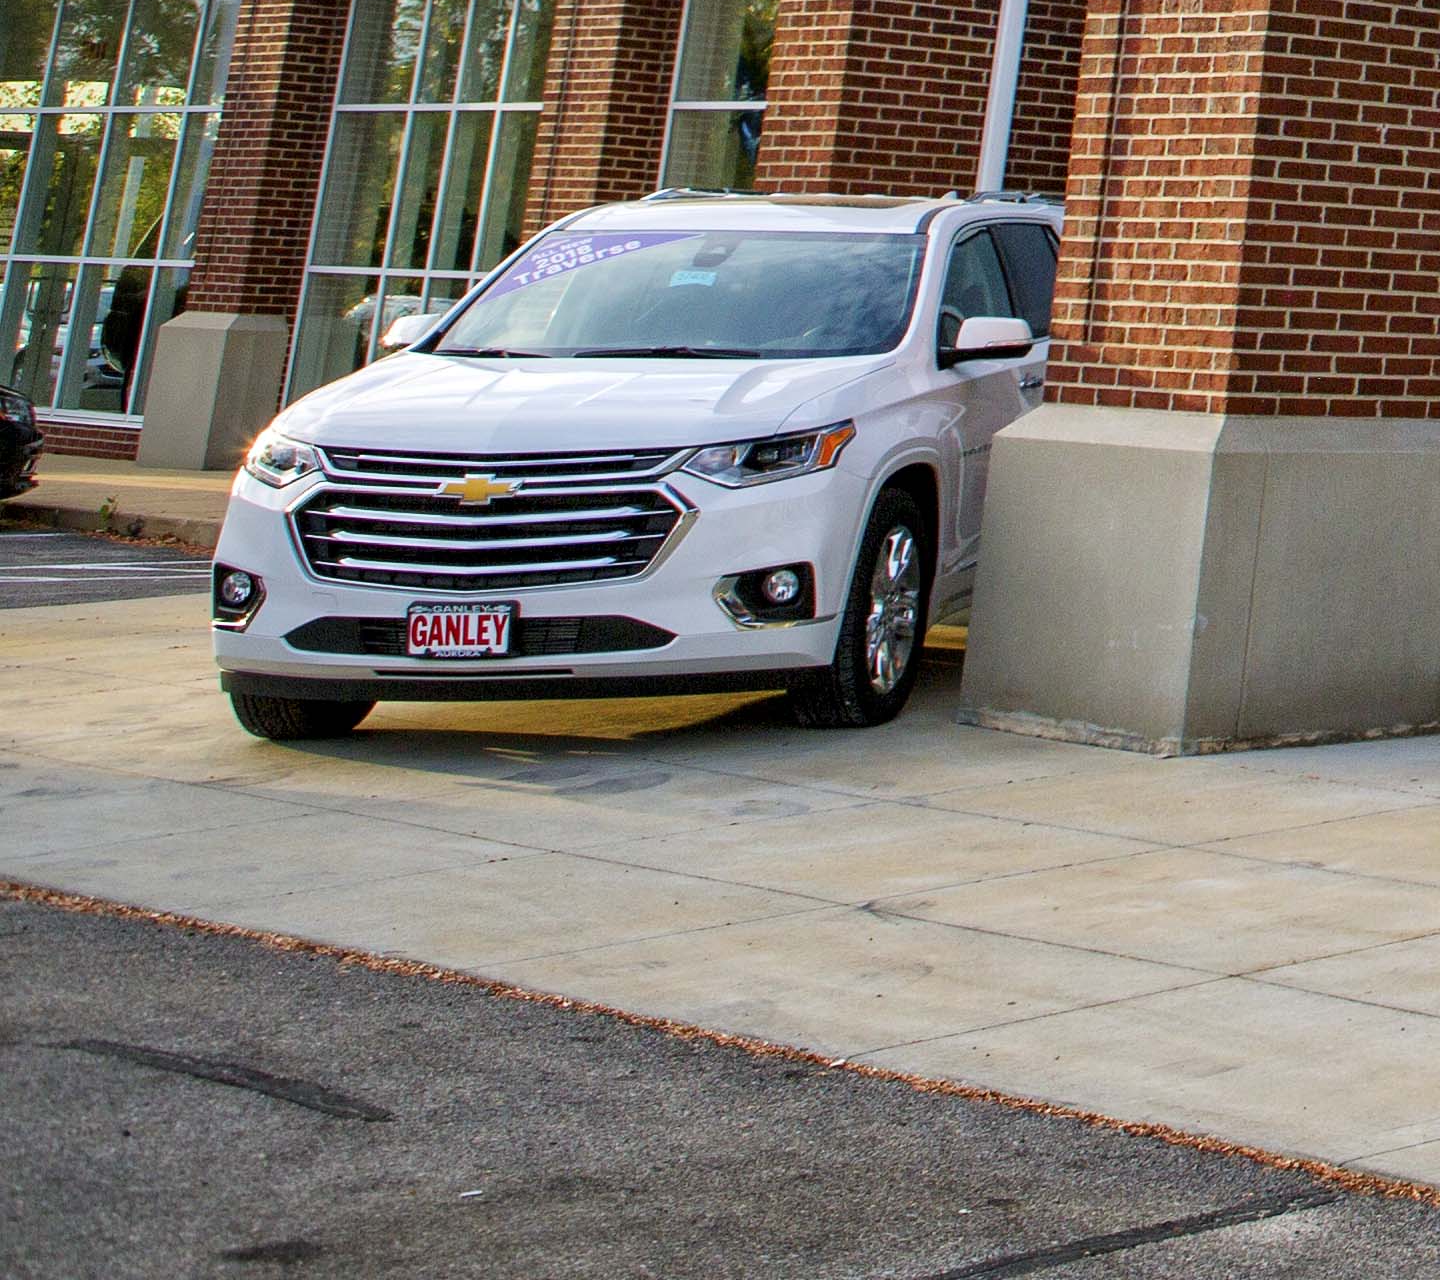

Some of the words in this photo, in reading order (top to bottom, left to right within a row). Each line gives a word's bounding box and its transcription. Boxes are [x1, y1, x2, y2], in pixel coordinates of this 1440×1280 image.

[513, 240, 641, 286] Traverse
[535, 245, 593, 270] 2018
[433, 604, 490, 613] GANLEY
[411, 614, 509, 648] GANLEY
